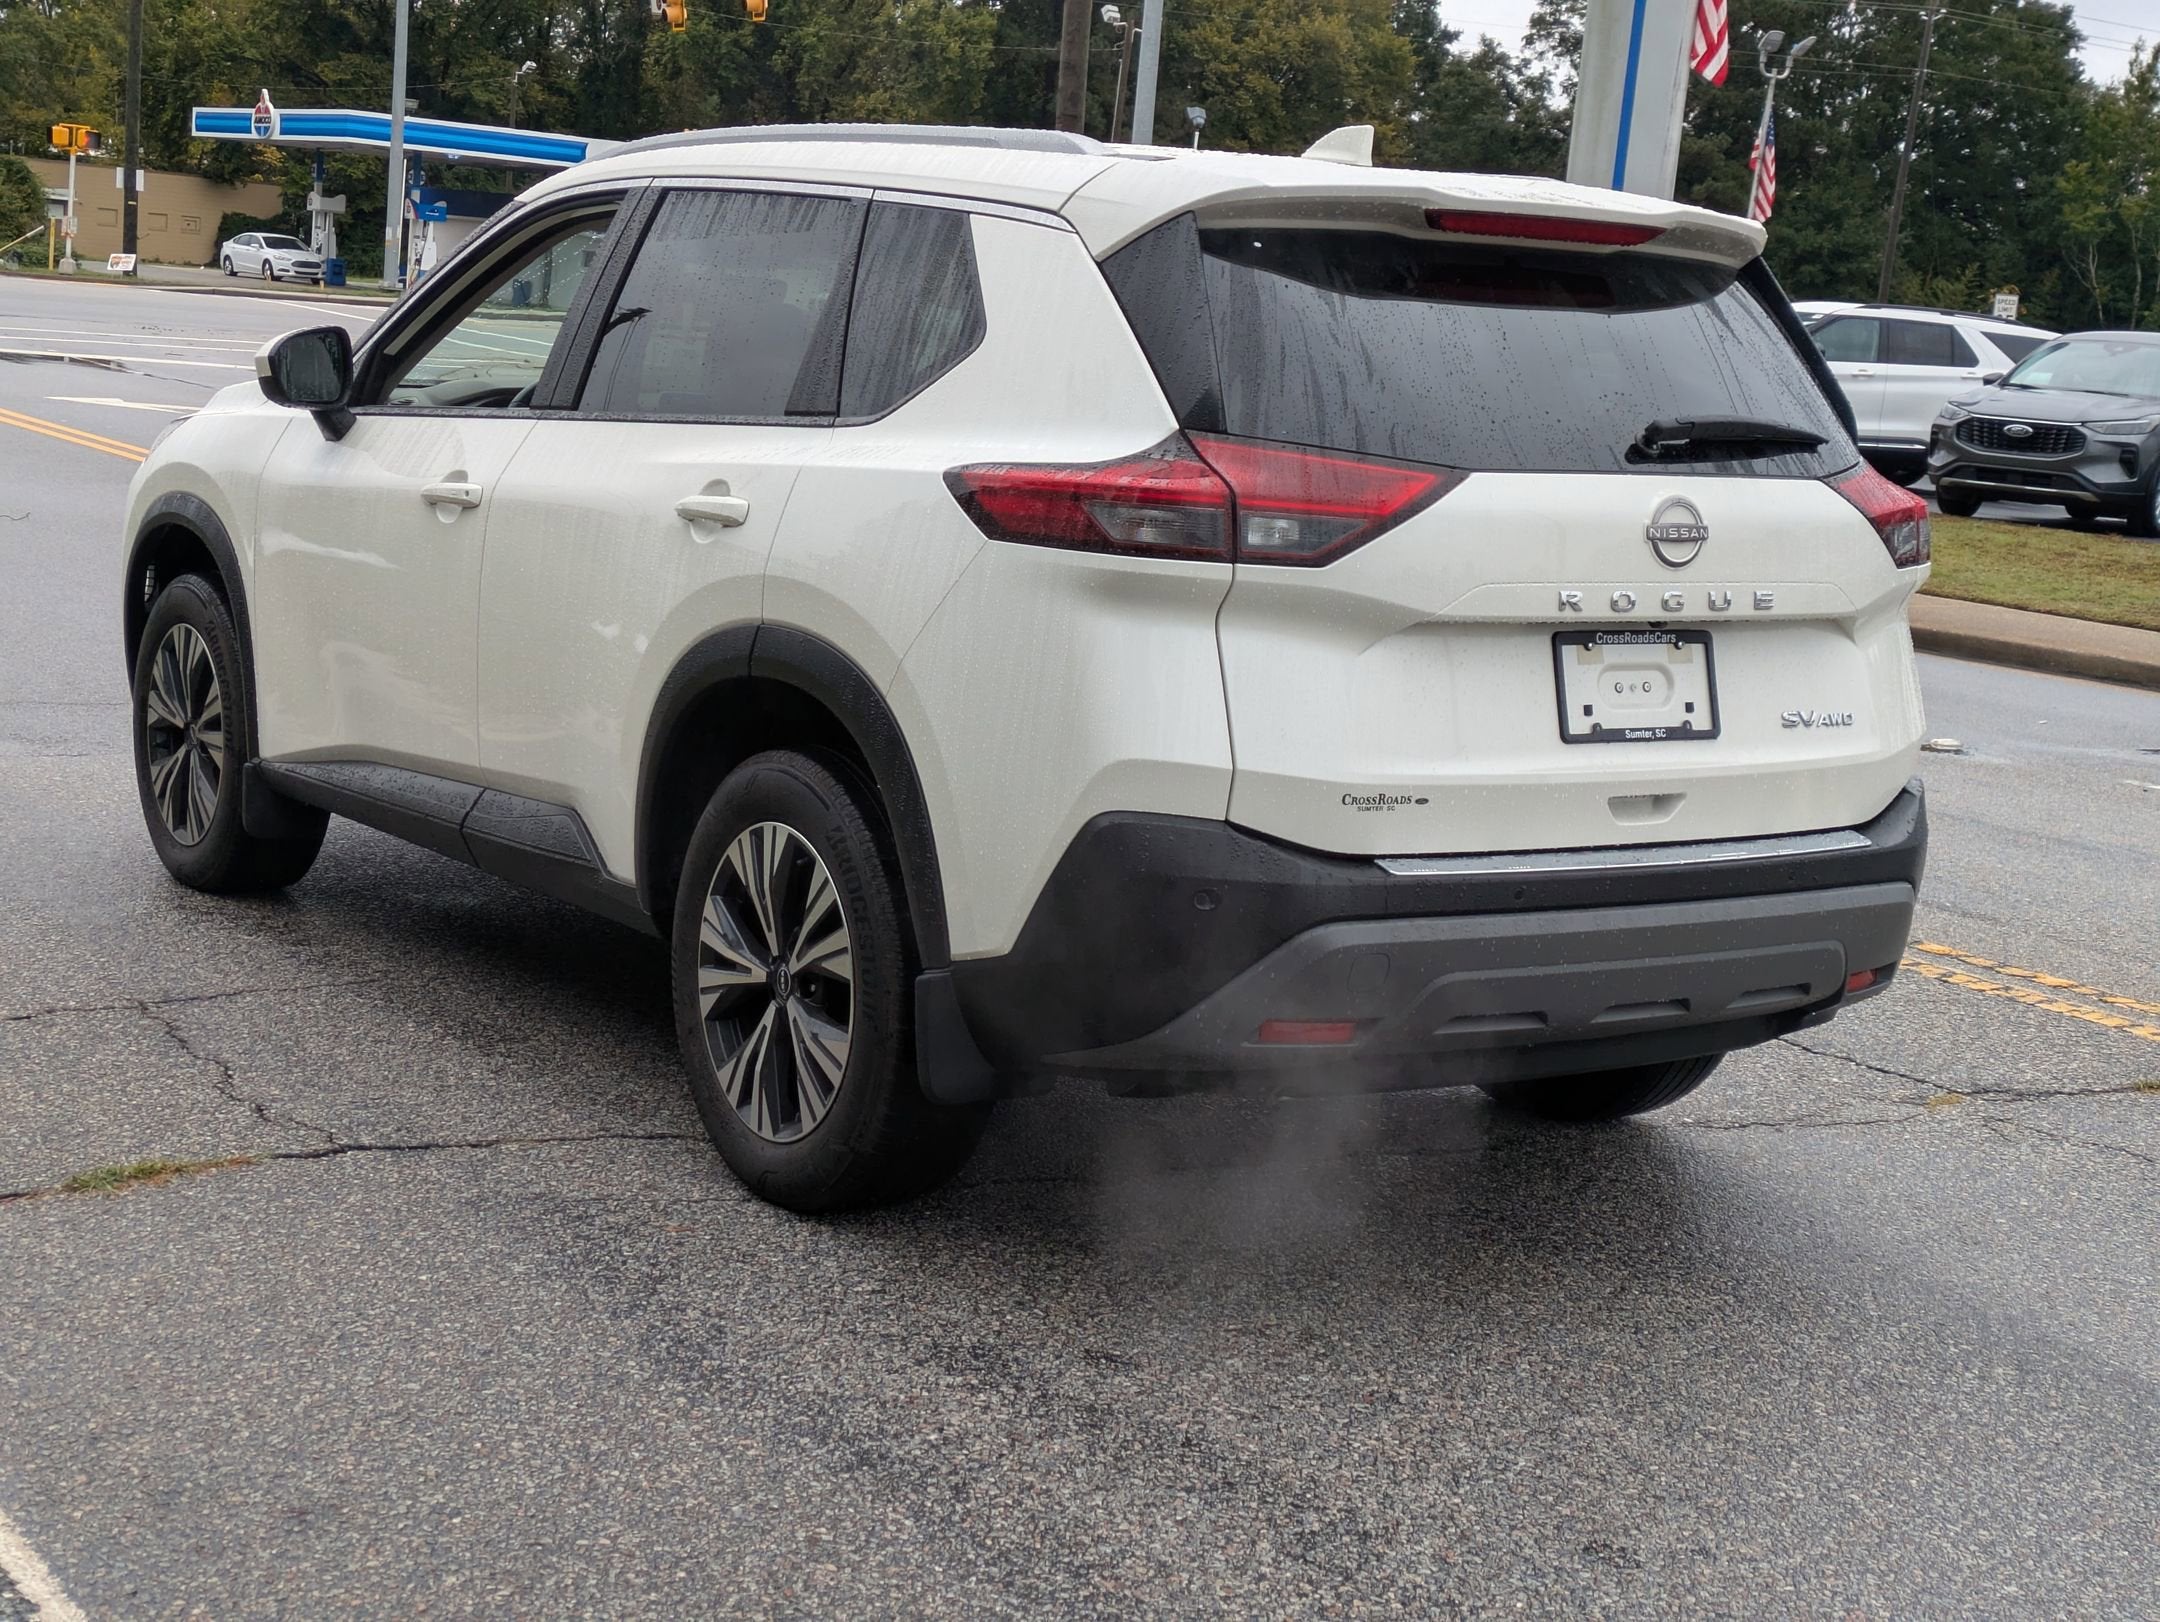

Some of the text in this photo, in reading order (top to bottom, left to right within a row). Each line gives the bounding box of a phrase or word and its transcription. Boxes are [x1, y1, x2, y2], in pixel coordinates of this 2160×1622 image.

[1649, 527, 1708, 538] NISSAN
[1558, 590, 1775, 613] ROGUE
[1596, 631, 1677, 644] CrossRoadsCars
[1625, 729, 1667, 740] Sumter, SC
